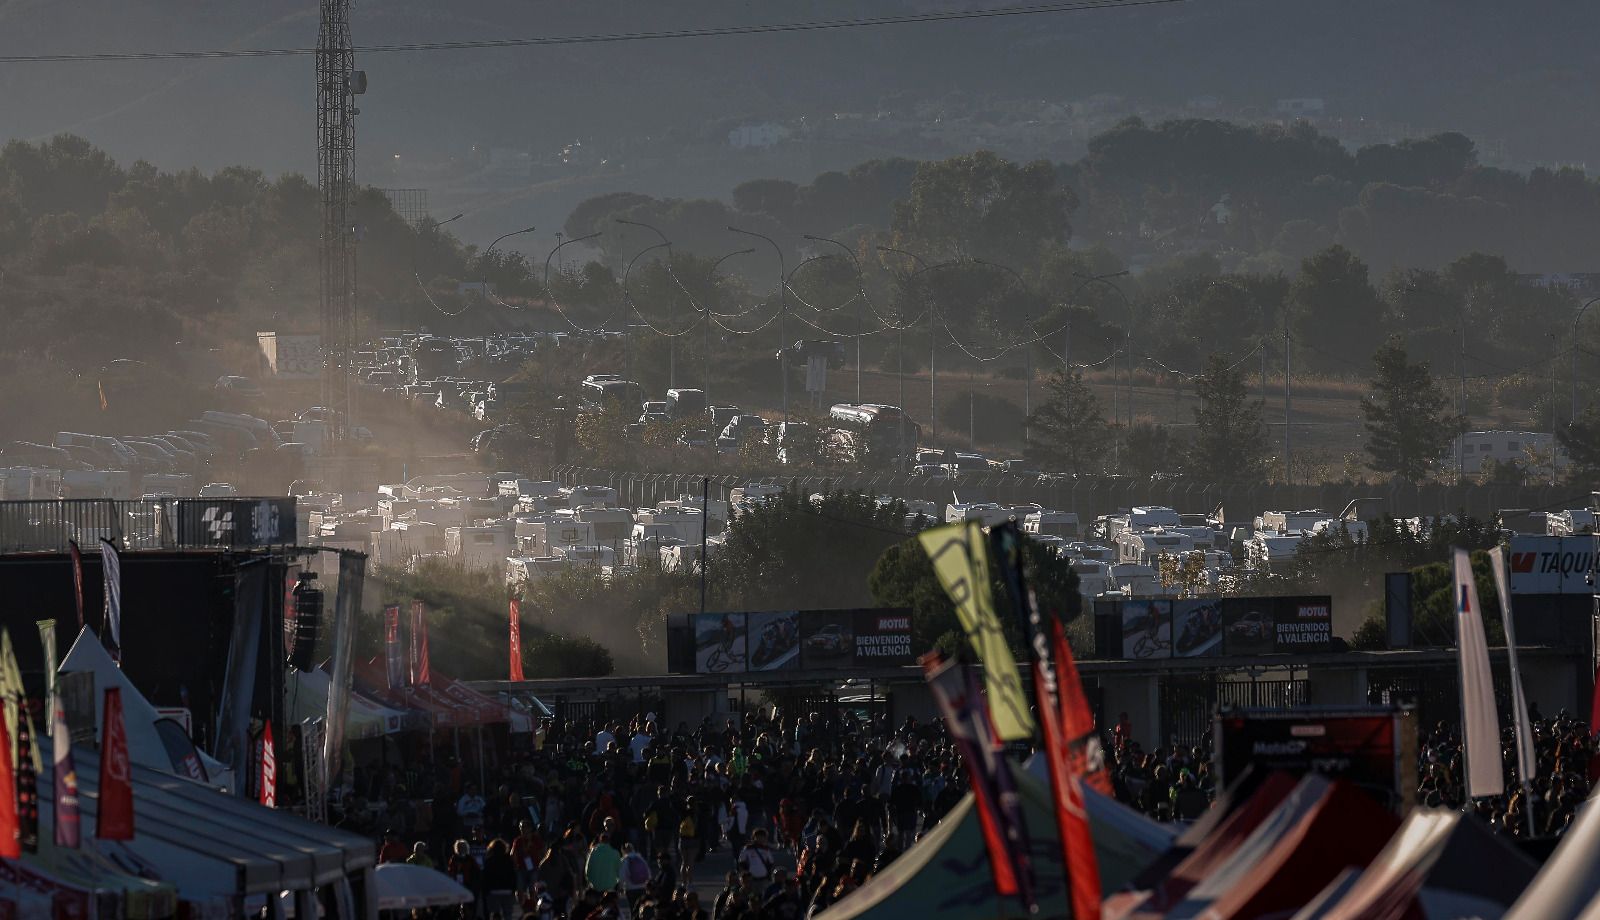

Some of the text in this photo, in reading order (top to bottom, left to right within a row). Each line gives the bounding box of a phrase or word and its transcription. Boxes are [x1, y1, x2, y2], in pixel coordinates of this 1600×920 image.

[1299, 606, 1328, 617] MOTUL
[879, 618, 909, 629] MOTUL
[1277, 623, 1329, 633] BIENVENIDOS
[856, 635, 911, 646] BIENVENIDOS
[1277, 632, 1329, 644] A VALENCIA
[856, 645, 911, 656] A VALENCIA
